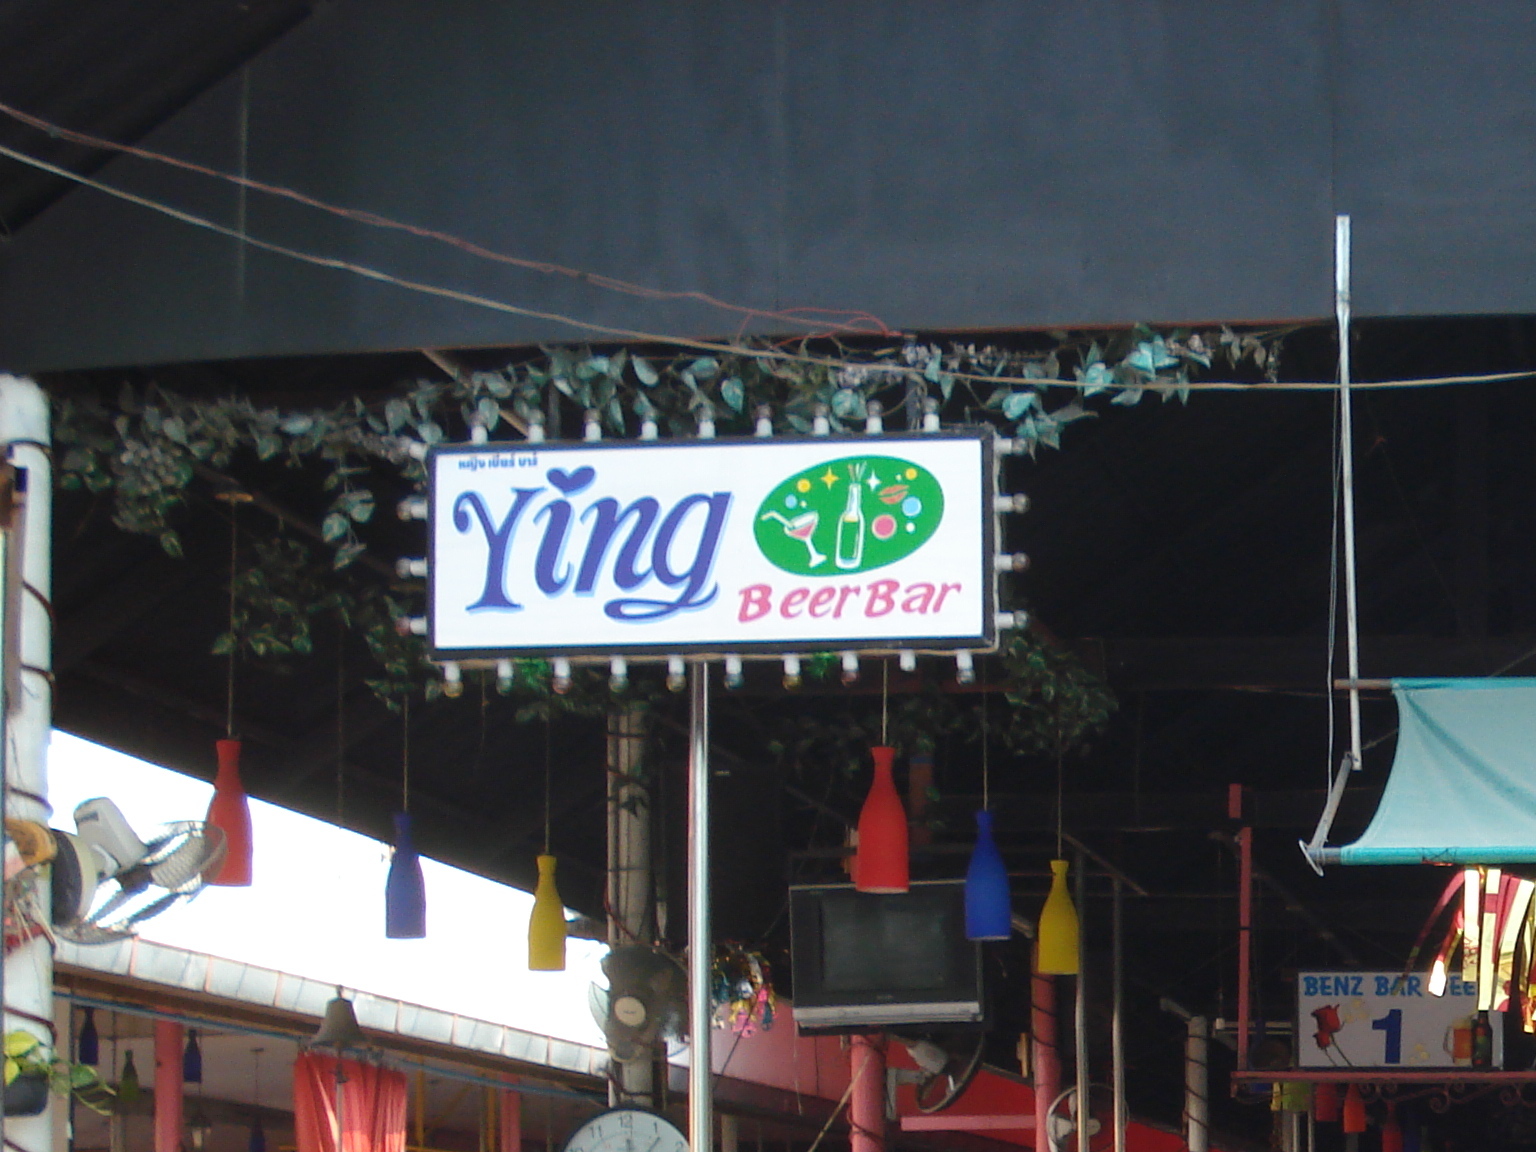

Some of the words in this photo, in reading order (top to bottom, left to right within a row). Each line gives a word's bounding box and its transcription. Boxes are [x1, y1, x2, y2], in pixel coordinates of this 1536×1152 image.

[452, 465, 733, 622] Ying
[1303, 976, 1364, 997] BENZ
[1375, 976, 1423, 997] BAR
[1372, 1008, 1402, 1064] 1
